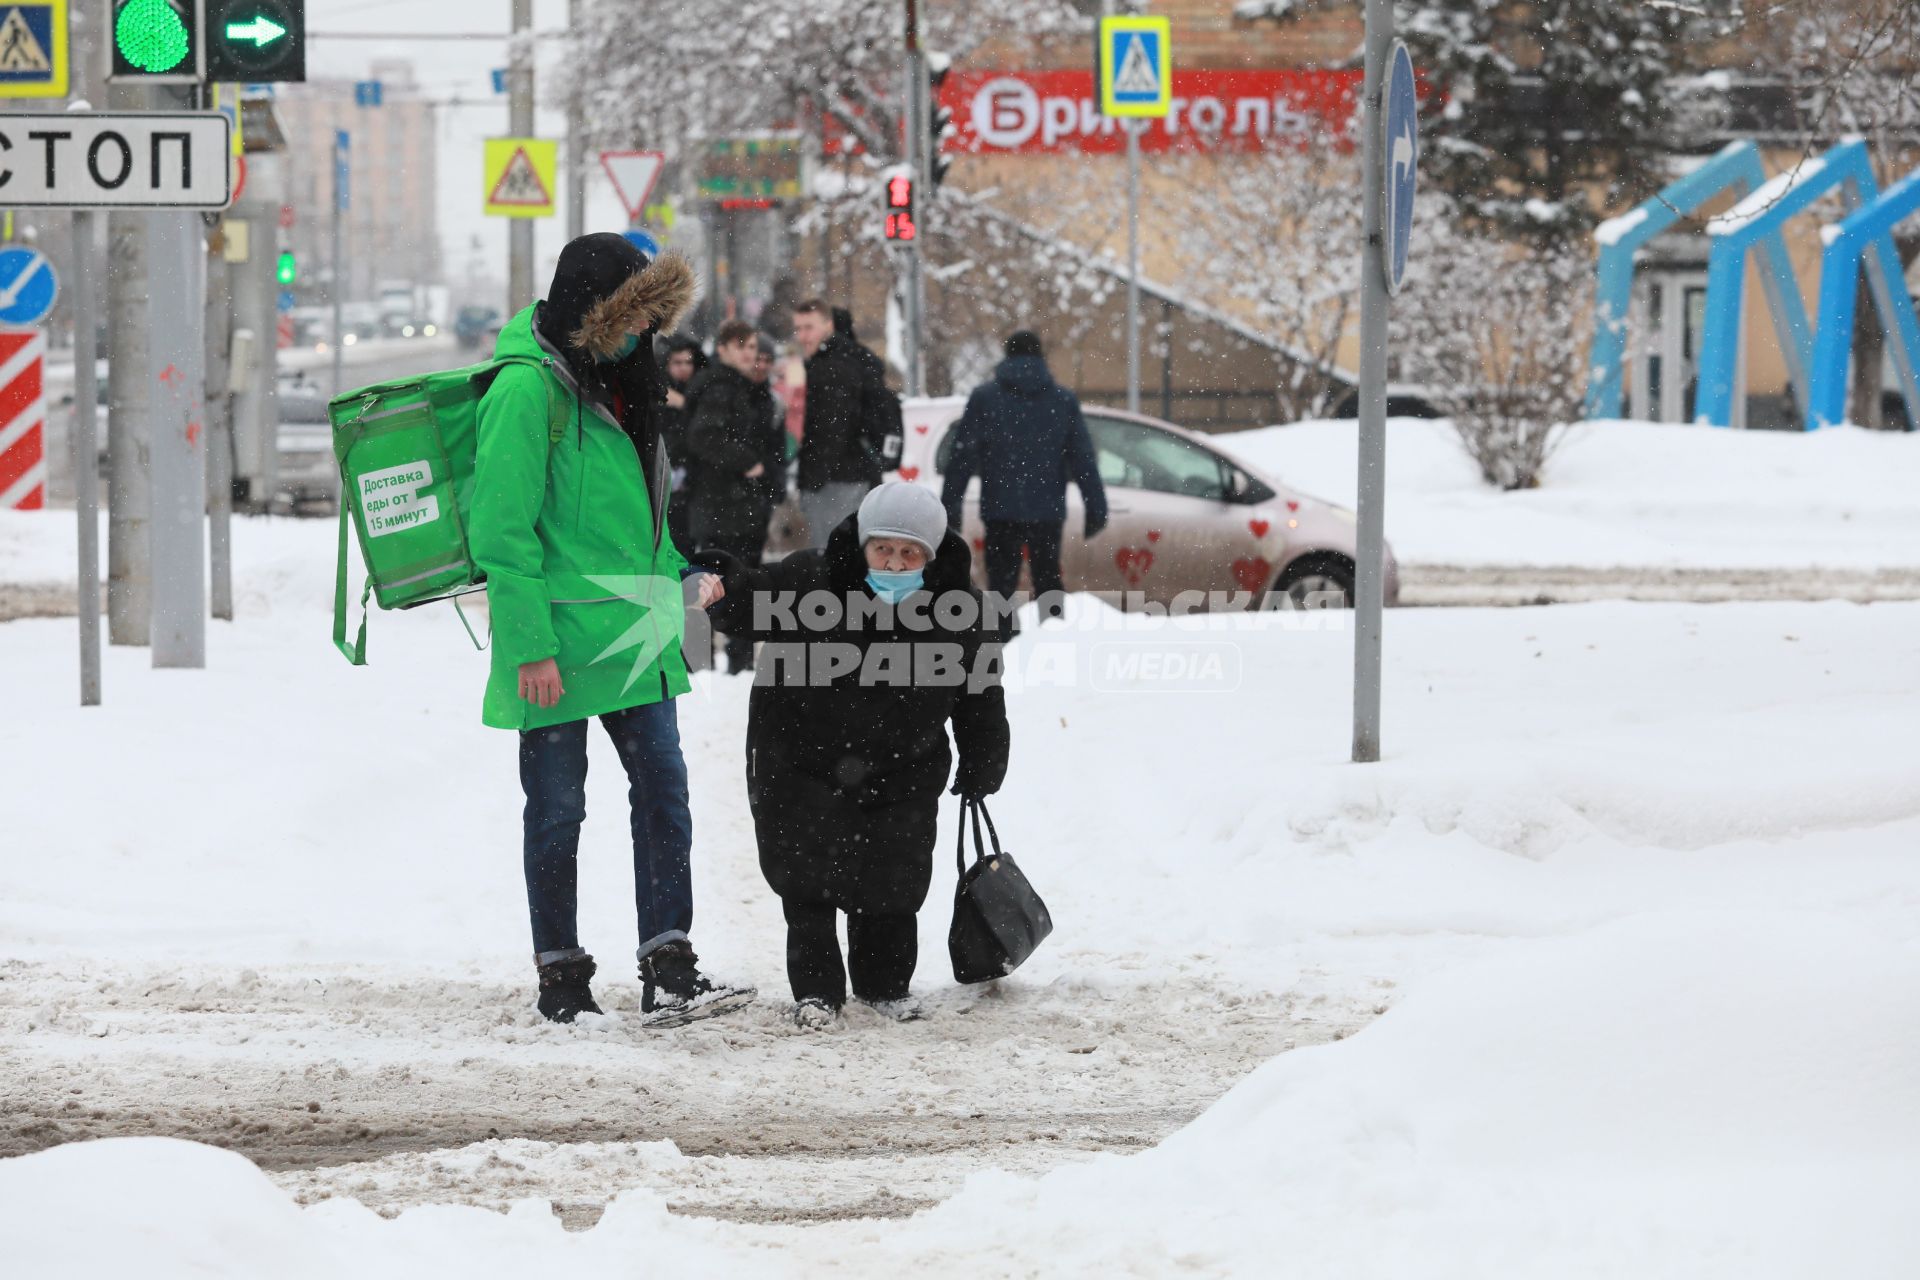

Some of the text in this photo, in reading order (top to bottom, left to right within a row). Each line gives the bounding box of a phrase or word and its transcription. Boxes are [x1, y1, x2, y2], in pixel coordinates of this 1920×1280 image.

[886, 212, 915, 240] 15
[364, 470, 424, 495] Доставка
[366, 493, 408, 512] еды от
[371, 507, 428, 530] 15 минут
